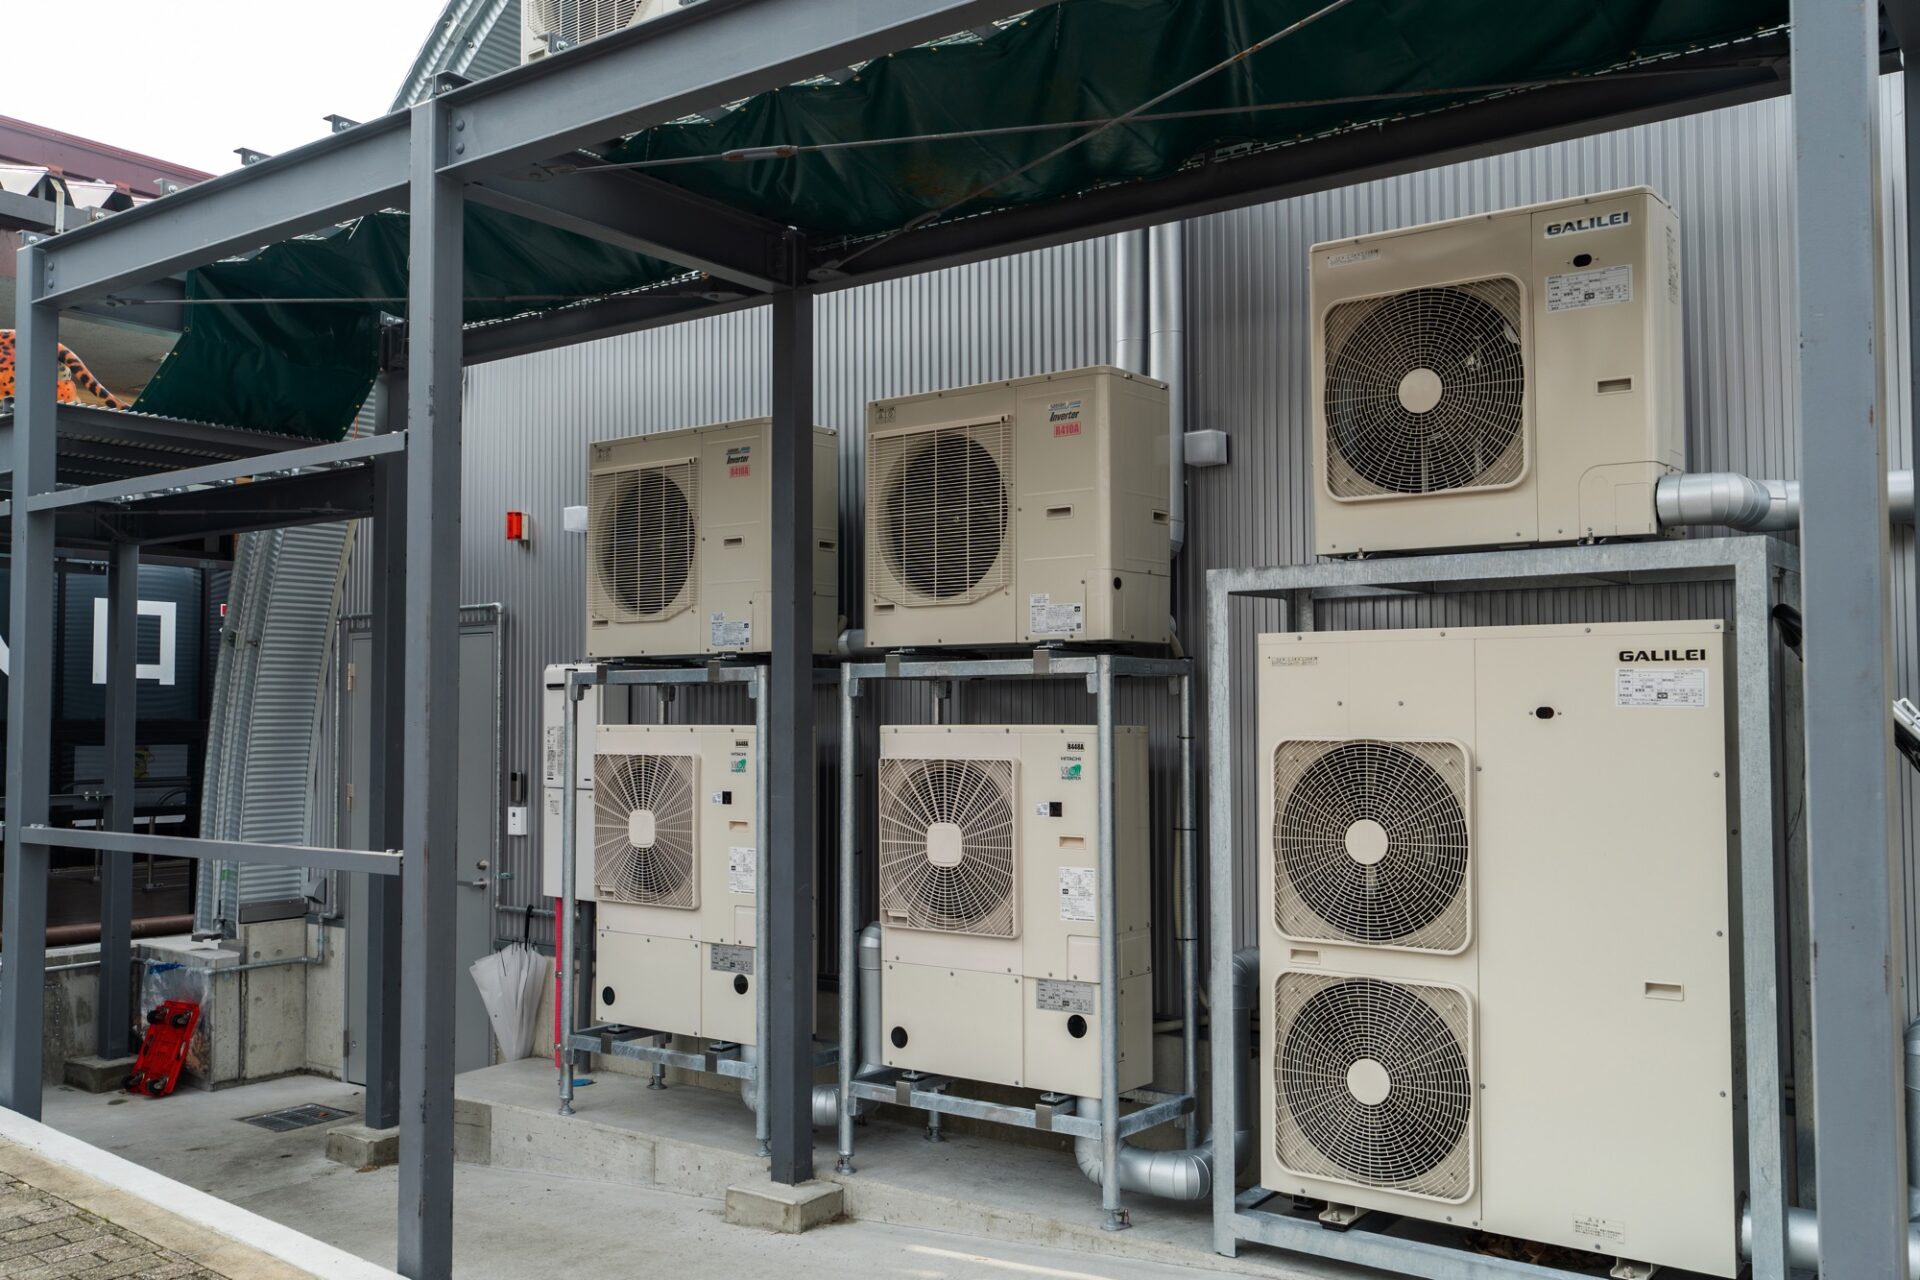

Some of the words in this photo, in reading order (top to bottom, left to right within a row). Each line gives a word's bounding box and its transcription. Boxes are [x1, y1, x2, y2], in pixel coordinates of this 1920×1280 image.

[1547, 211, 1629, 236] GALILEI
[1049, 411, 1080, 422] Inverter
[1055, 423, 1080, 436] R410A
[1618, 649, 1706, 662] GALILEI
